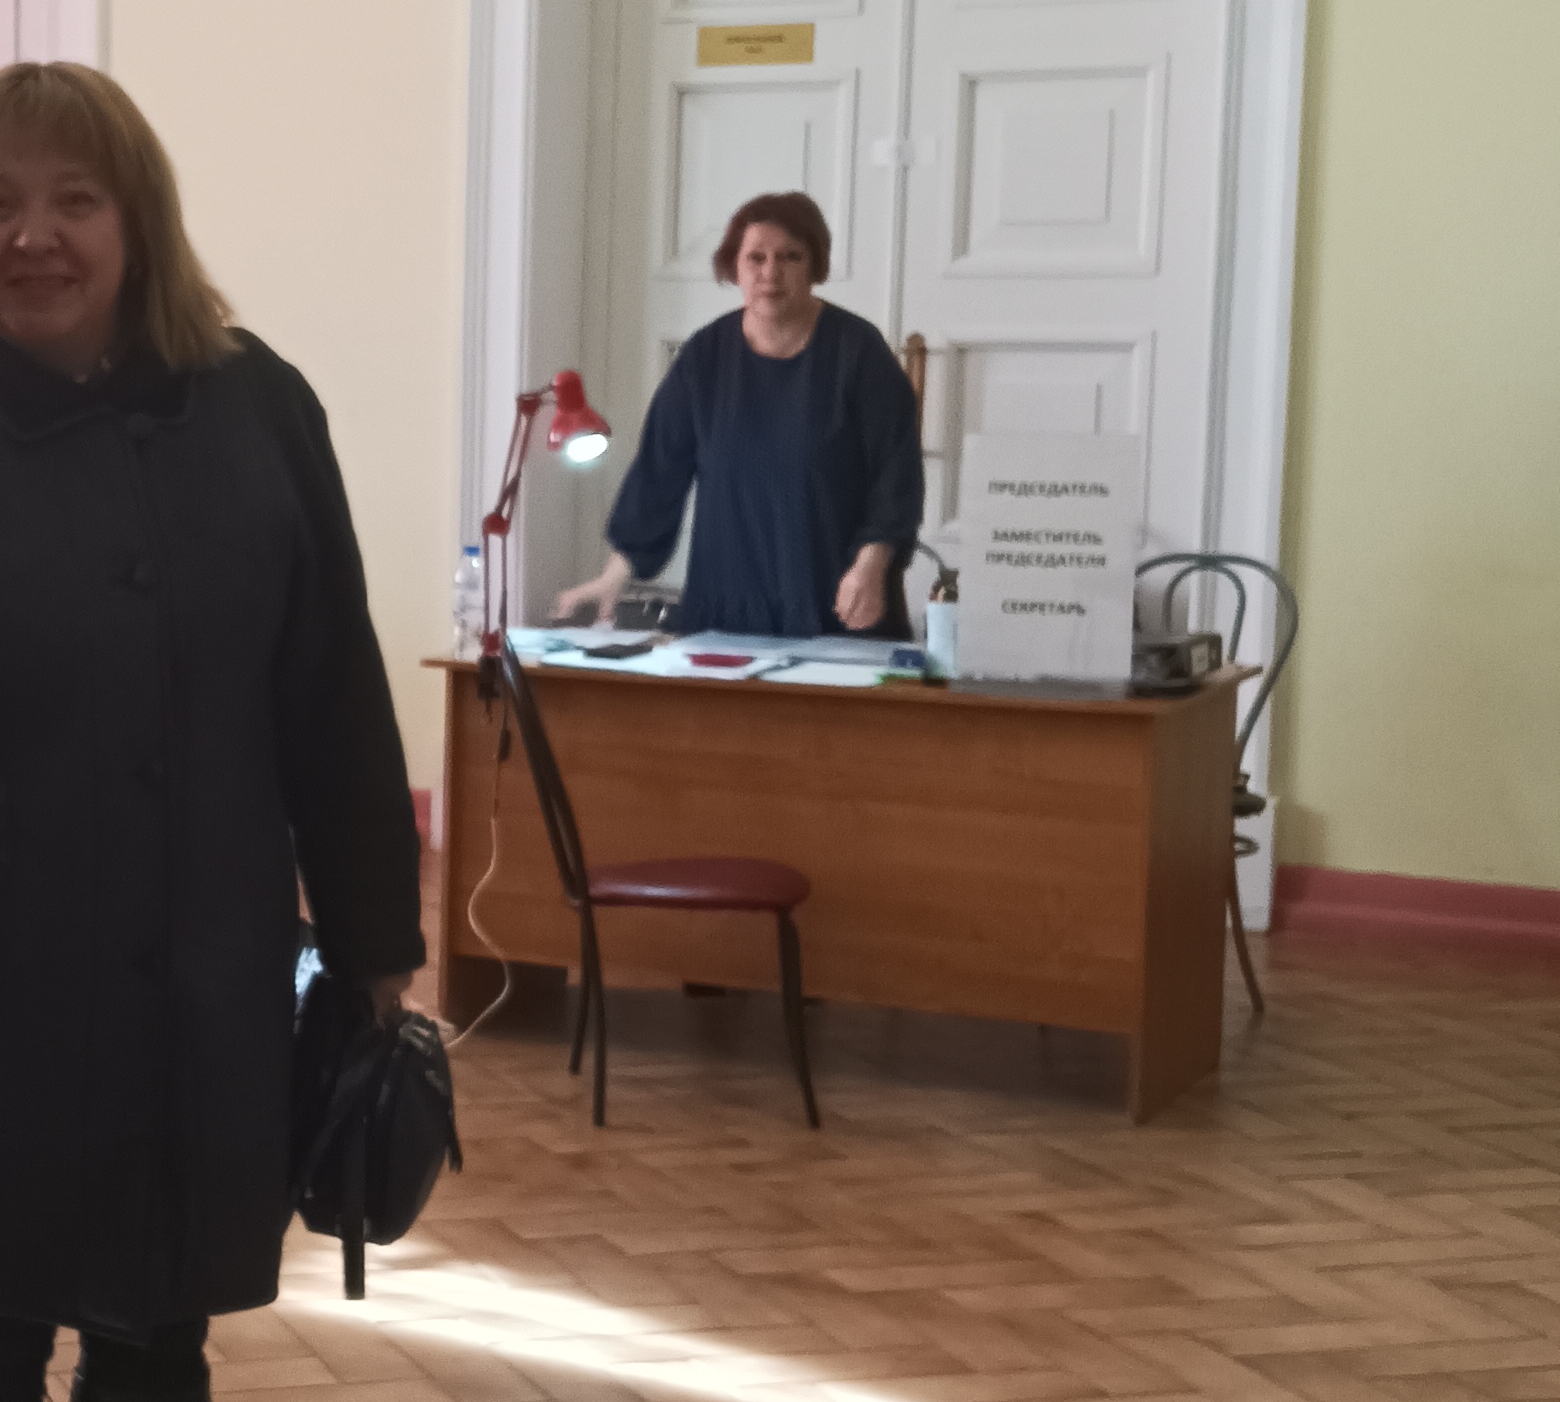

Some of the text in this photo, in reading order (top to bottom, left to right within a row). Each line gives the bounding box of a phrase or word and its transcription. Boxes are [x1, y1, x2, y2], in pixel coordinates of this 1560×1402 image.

[988, 480, 1110, 497] ПРЕДСЕДАТЕЛЬ
[992, 528, 1103, 545] ЗАМЕСТИТЕЛЬ
[986, 552, 1107, 568] ПРЕДСЕДАТЕЛЯ
[1001, 599, 1087, 616] СЕКРЕТАРЬ
